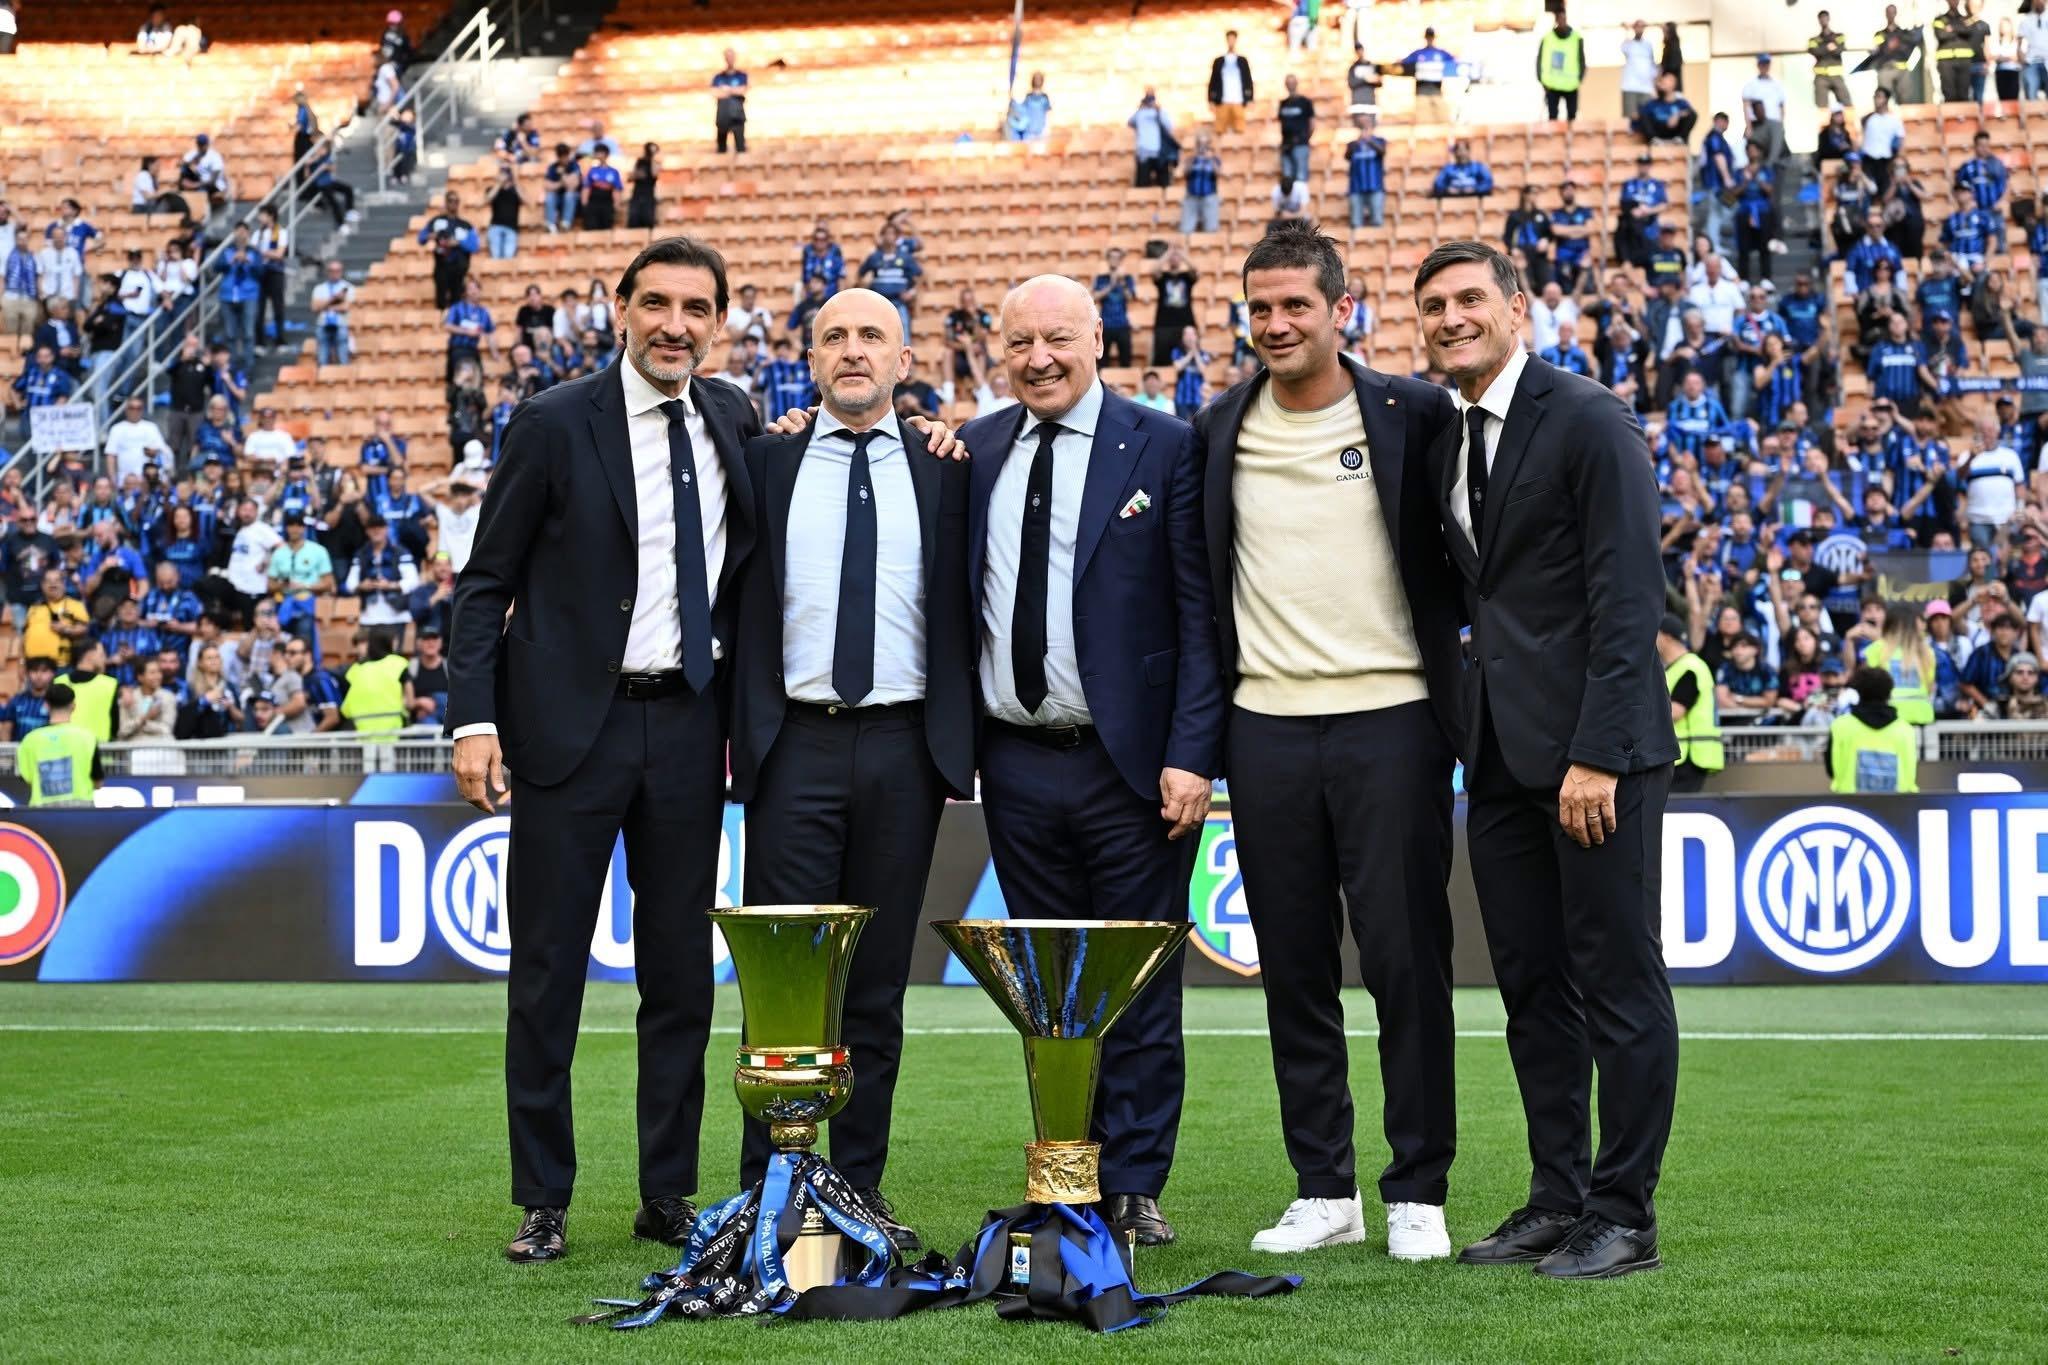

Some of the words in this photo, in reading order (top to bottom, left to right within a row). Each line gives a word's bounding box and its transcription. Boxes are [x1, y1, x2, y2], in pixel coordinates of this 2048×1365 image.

[1336, 472, 1370, 482] CANALI
[794, 1178, 807, 1210] COPP
[761, 1210, 777, 1240] COPPA
[831, 1211, 861, 1235] ITALIA
[761, 1240, 777, 1277] ITALIA
